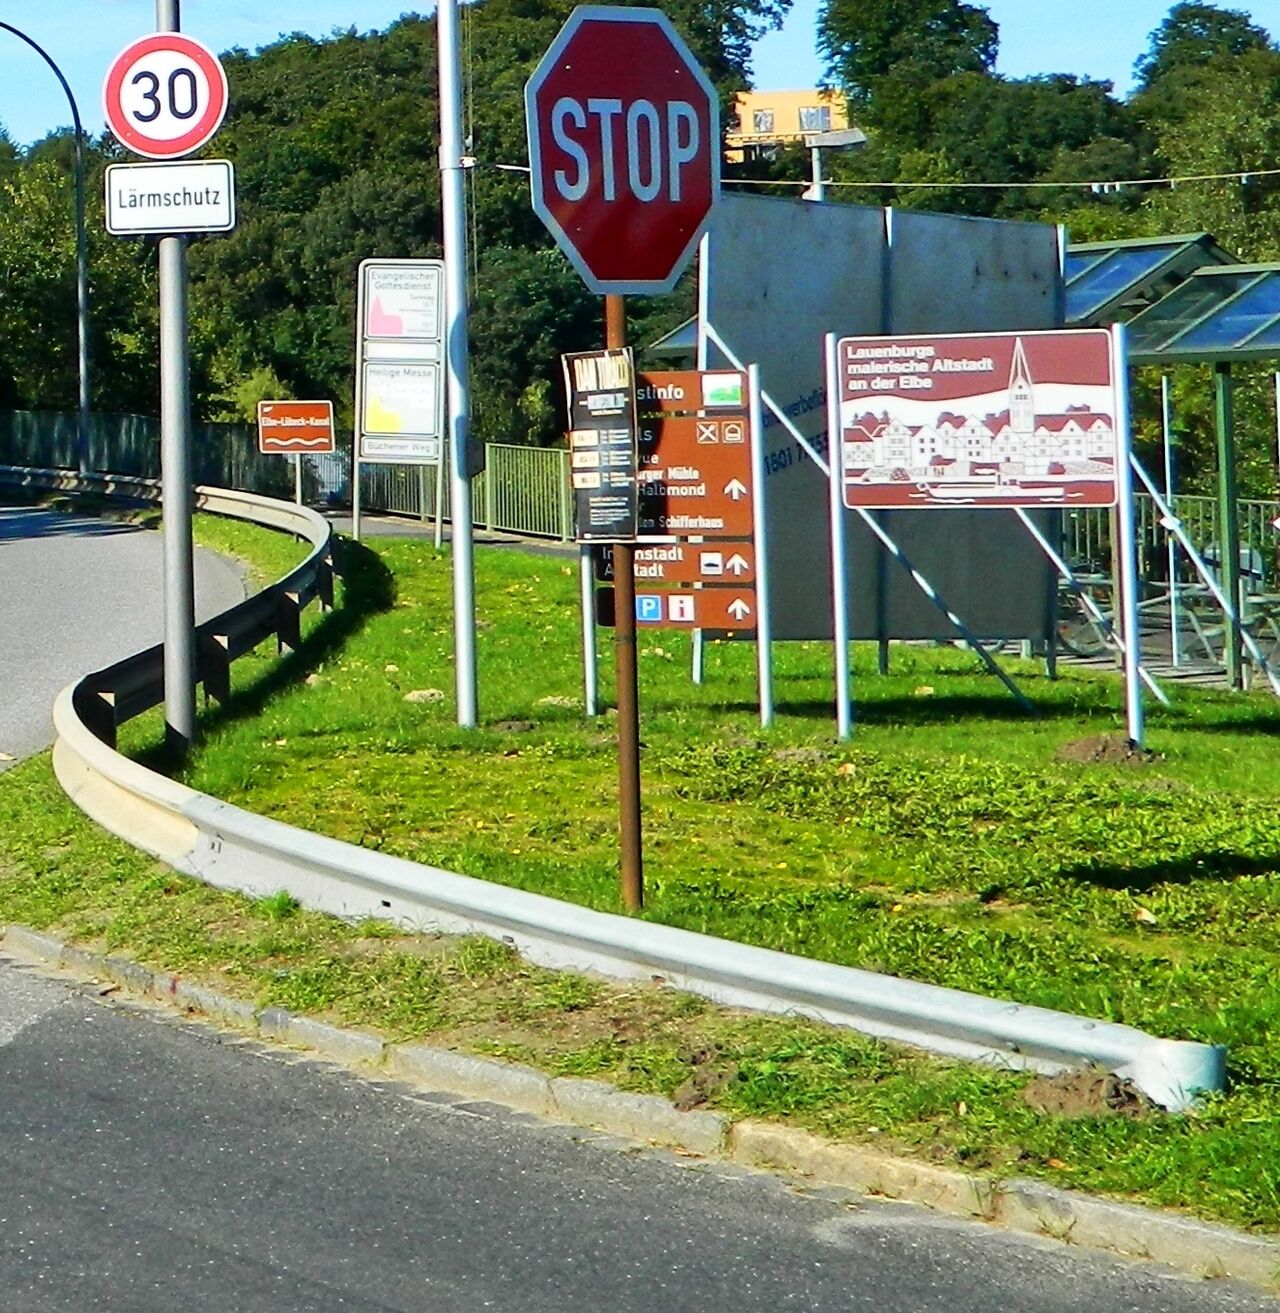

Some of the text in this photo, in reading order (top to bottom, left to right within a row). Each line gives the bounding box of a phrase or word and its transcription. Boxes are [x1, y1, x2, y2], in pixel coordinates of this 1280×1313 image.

[132, 68, 198, 123] 30
[551, 96, 700, 202] STOP
[118, 187, 221, 209] Lärmschutz
[371, 271, 435, 281] Evangelischer
[375, 281, 431, 290] Gottesdienst
[846, 345, 935, 359] Lauenburgs
[369, 369, 433, 378] Heilige Messe
[847, 358, 994, 375] malerische Altstadt
[848, 375, 933, 390] an der Elbe
[636, 384, 684, 400] stinfo
[637, 470, 664, 482] urger
[667, 466, 700, 480] Mühle
[658, 514, 724, 529] Schifferhaus
